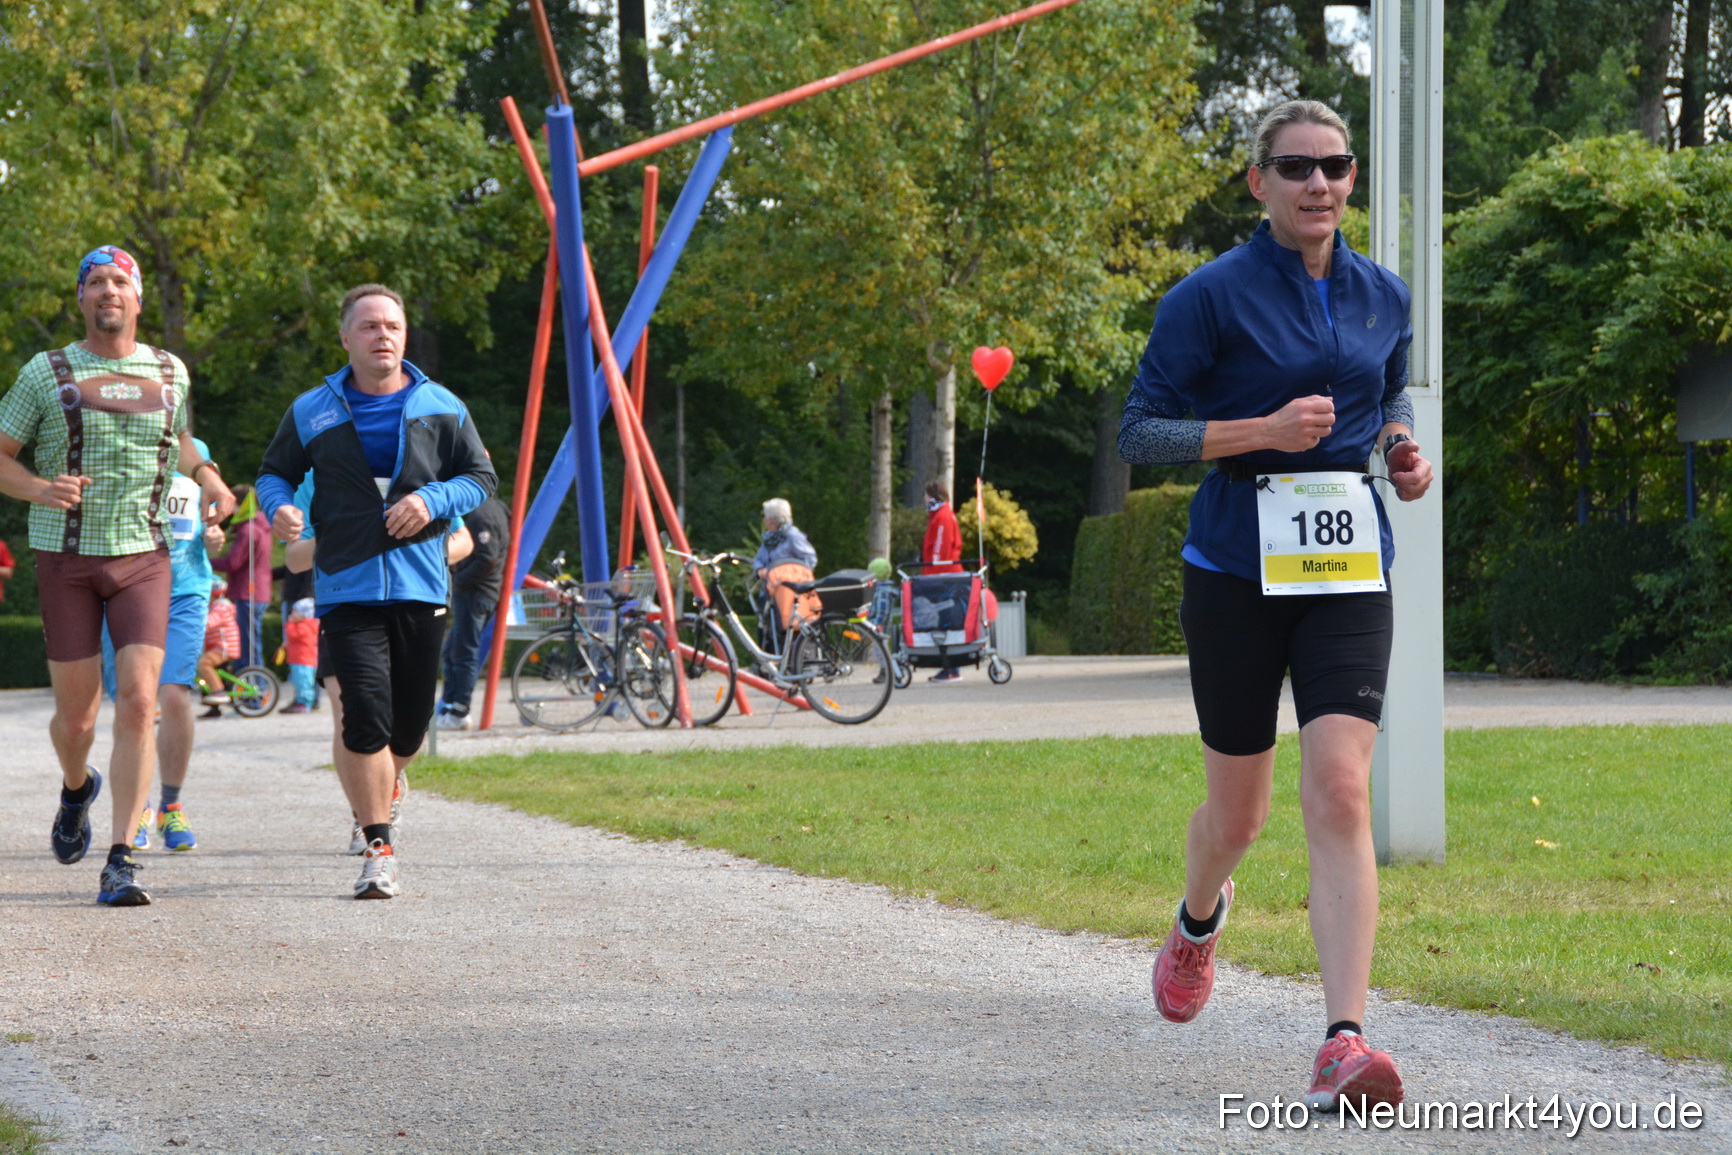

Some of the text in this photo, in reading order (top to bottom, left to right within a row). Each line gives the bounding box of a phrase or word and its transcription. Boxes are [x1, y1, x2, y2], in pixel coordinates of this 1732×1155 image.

[1307, 483, 1347, 494] BOCK
[1291, 510, 1354, 546] 188
[1302, 559, 1348, 573] Martina
